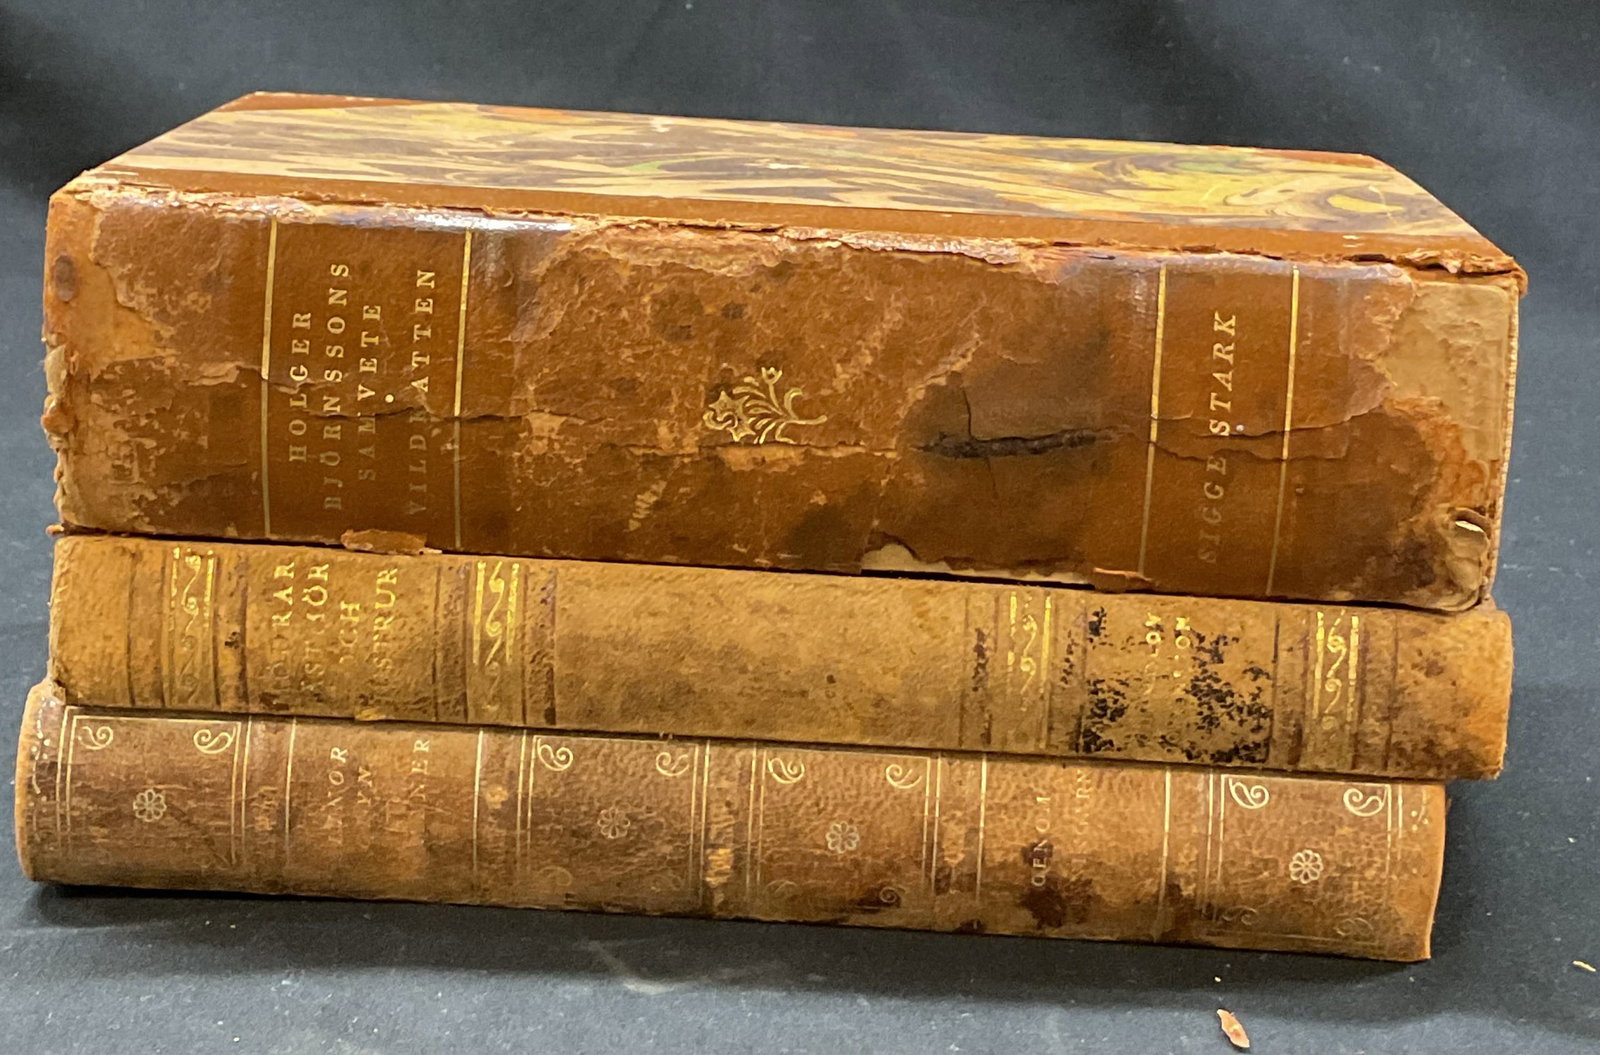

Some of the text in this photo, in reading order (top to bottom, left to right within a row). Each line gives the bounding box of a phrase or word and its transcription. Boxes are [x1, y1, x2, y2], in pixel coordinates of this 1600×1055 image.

[289, 312, 312, 462] HOLGER
[319, 263, 350, 510] BJÖRNSSONS
[358, 304, 382, 481] SAMVETE
[409, 269, 436, 515] VILDKATTEN
[1200, 310, 1237, 564] SIGGE STARK
